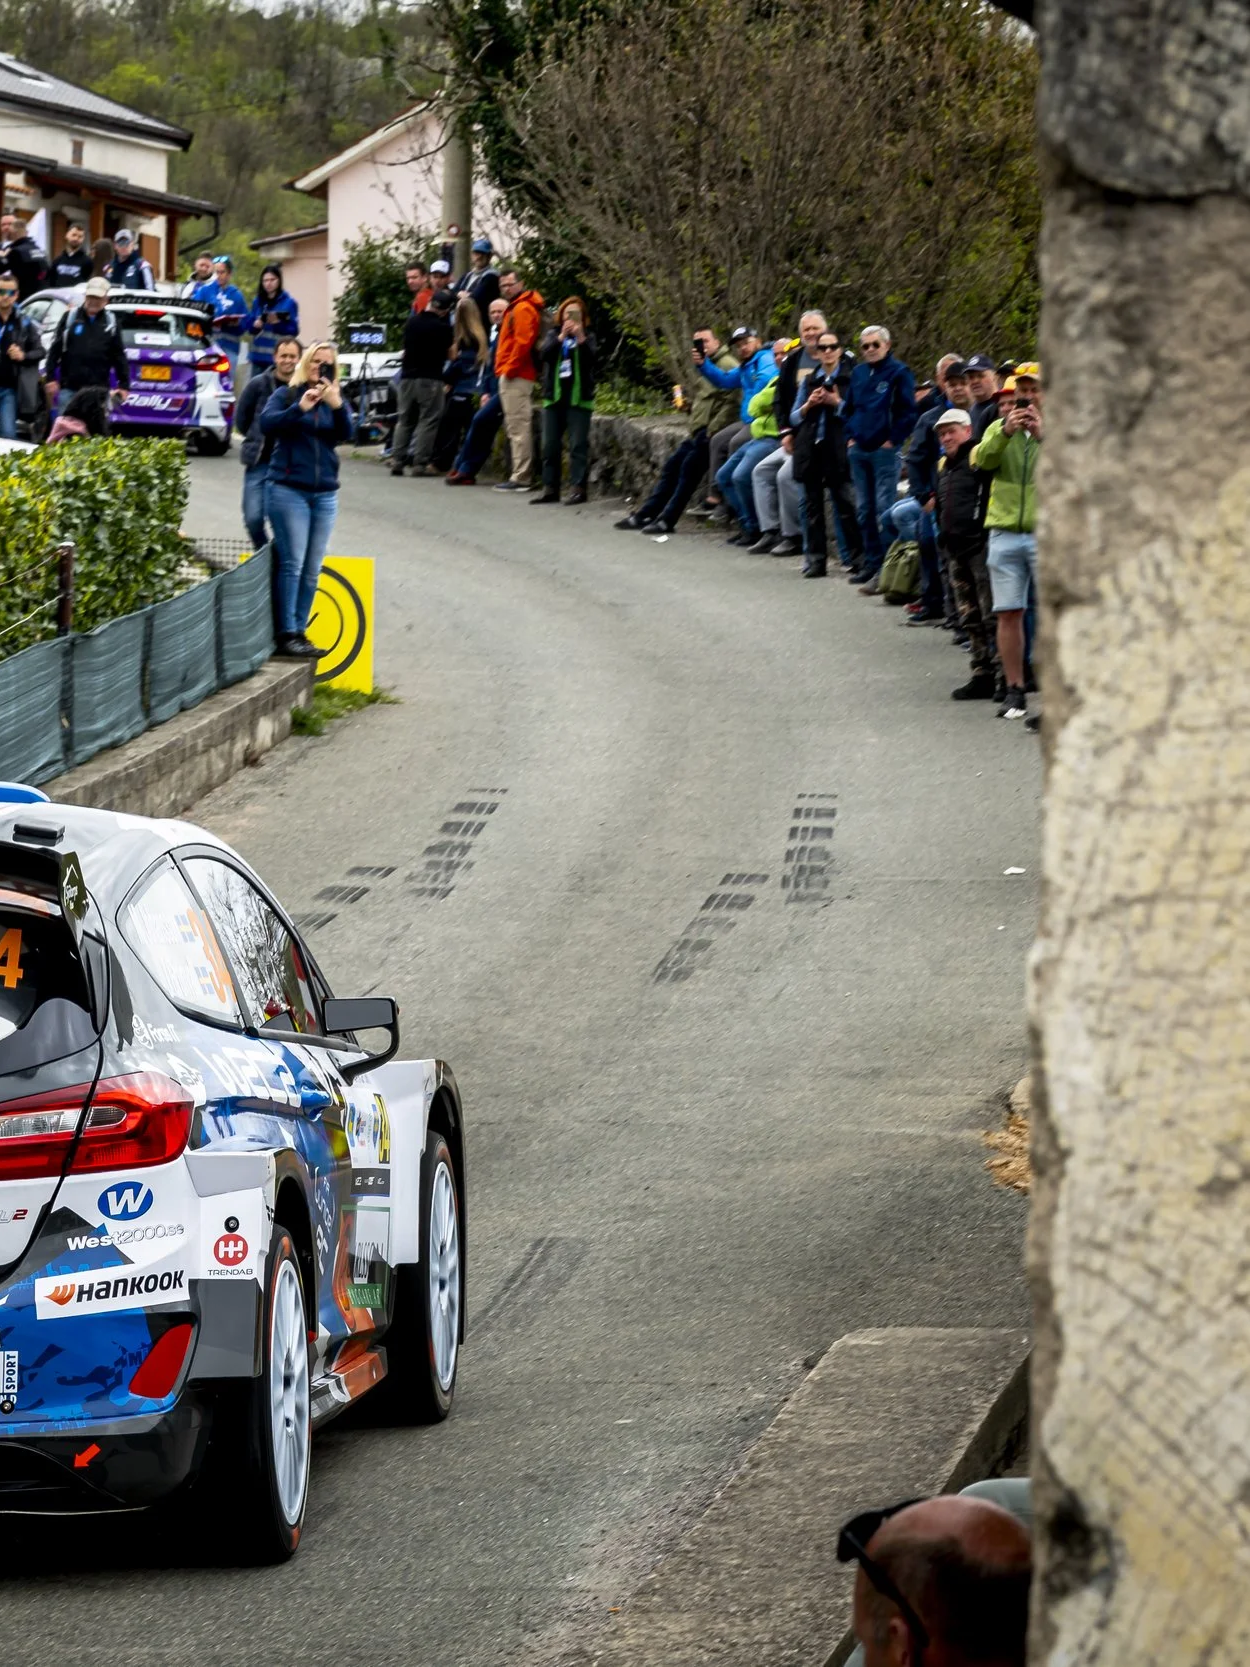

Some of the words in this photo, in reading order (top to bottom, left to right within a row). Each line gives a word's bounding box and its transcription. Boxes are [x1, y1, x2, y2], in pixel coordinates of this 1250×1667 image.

[107, 1183, 150, 1216] W
[66, 1222, 185, 1251] West2000.se
[207, 1268, 254, 1276] TRENDAB
[5, 1353, 16, 1391] SPORT
